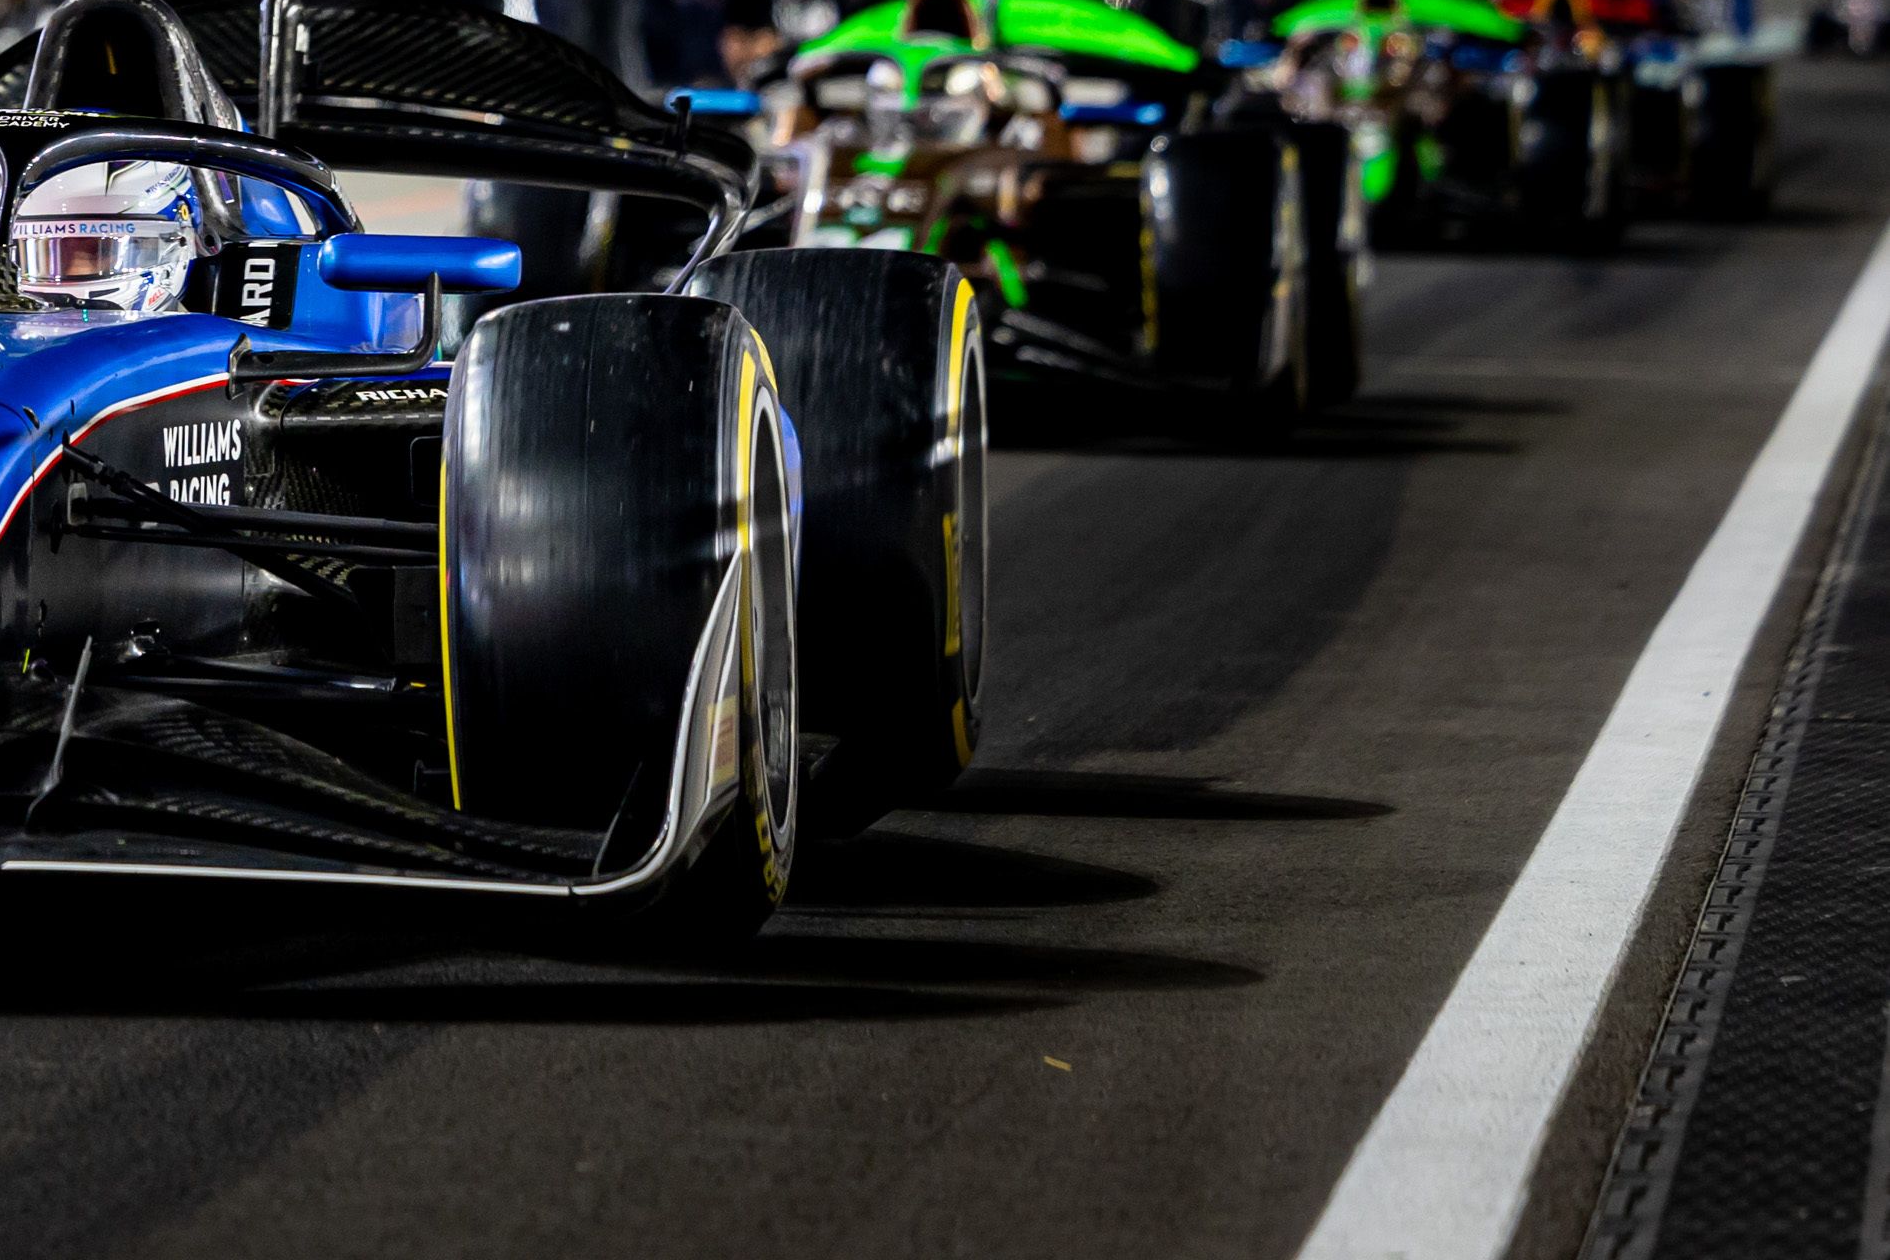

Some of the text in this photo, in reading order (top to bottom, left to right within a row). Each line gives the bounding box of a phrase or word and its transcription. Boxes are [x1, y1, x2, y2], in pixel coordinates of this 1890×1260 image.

[13, 223, 136, 235] ILLIAMS RACING
[162, 418, 242, 468] WILLIAMS
[169, 473, 231, 506] RACING
